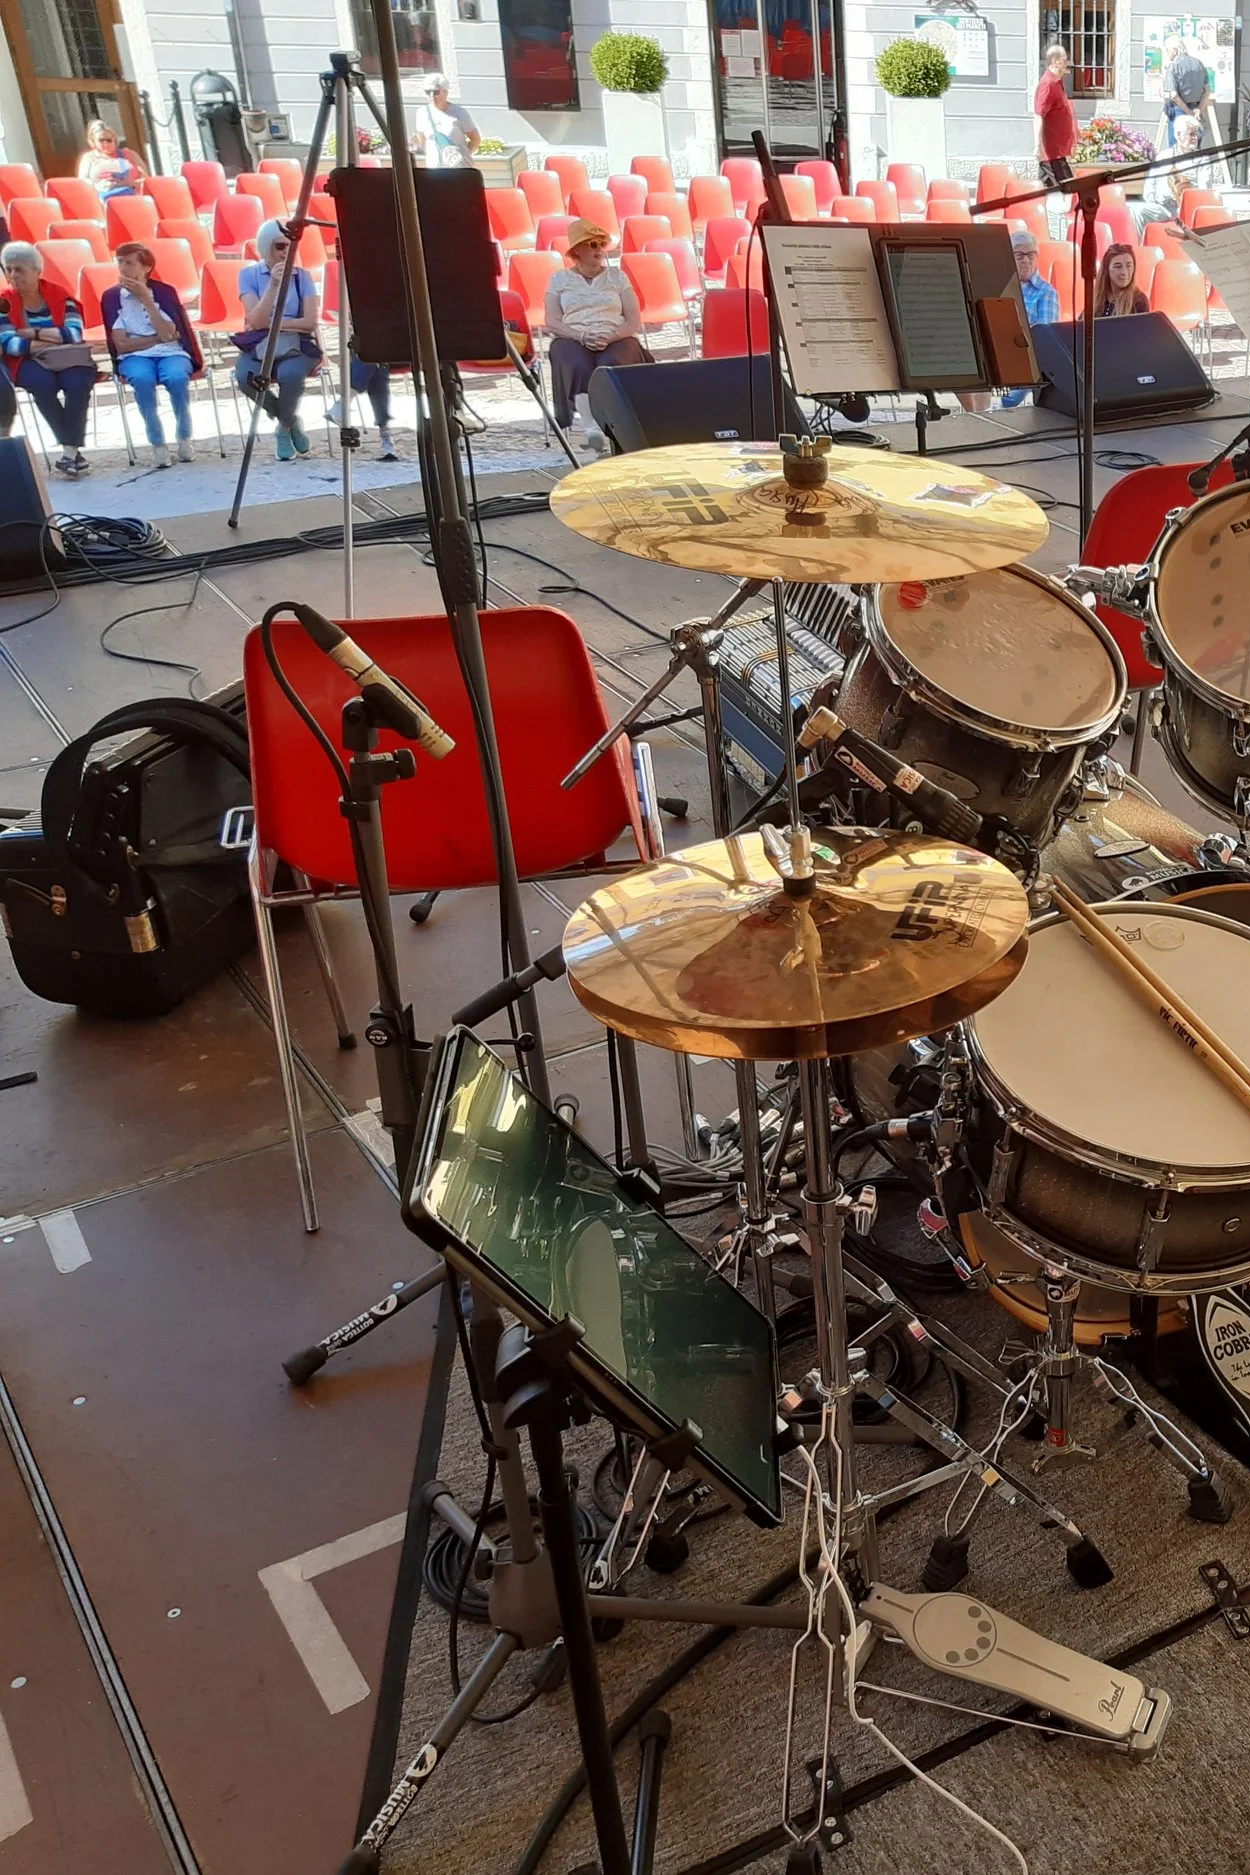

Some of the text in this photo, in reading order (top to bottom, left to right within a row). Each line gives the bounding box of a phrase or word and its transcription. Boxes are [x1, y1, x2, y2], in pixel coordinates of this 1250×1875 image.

[321, 1311, 370, 1345] MUSICA
[341, 1317, 375, 1342] BOTTEGA
[1215, 1320, 1247, 1342] IRON
[1231, 1361, 1243, 1373] The
[1098, 1680, 1125, 1722] Pearl
[362, 1779, 411, 1840] MUSICA
[388, 1784, 419, 1827] BOTTEGA
